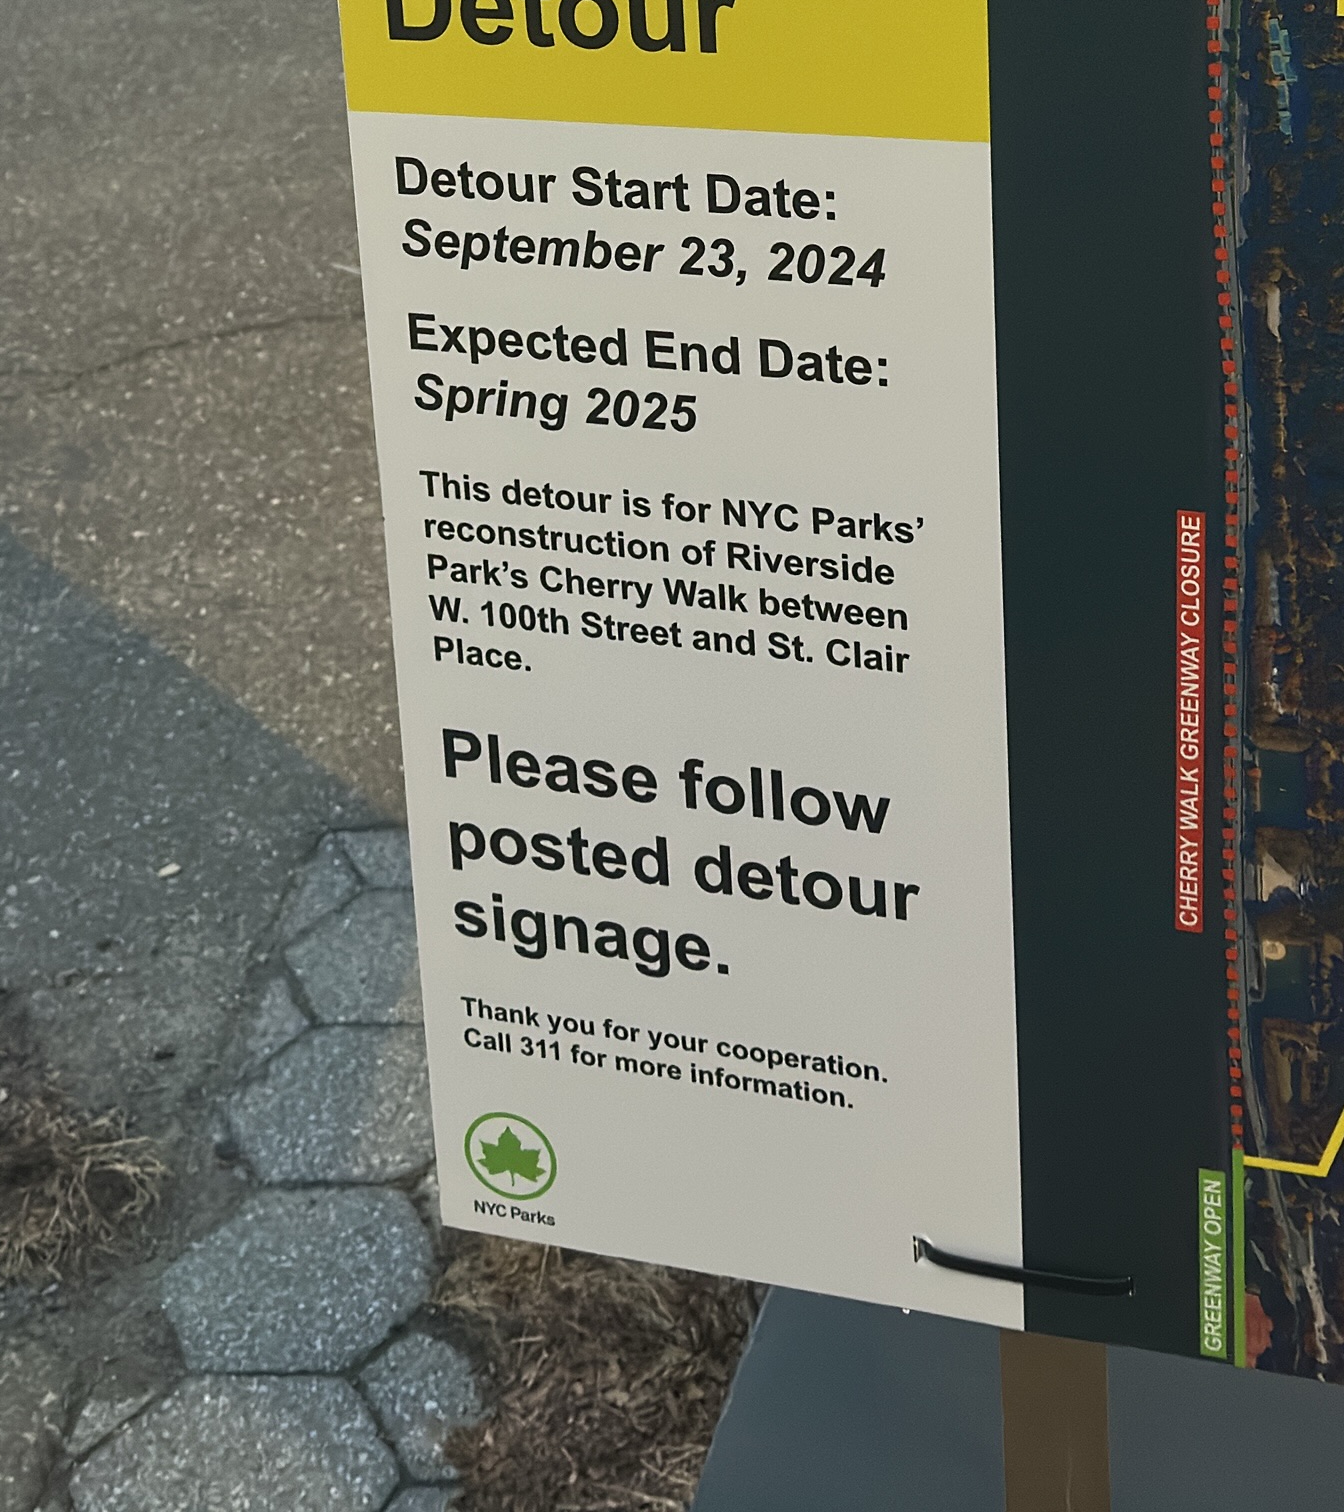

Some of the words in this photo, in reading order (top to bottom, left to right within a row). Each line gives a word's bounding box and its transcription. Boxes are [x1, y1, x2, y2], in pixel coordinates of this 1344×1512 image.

[395, 156, 557, 204] Detour
[571, 166, 691, 212] Start
[706, 173, 836, 221] Date:
[401, 218, 666, 273] September
[679, 236, 747, 287] 23,
[767, 241, 886, 288] 2024
[407, 312, 628, 367] Expected
[645, 329, 741, 376] End
[759, 338, 888, 387] Date:
[414, 372, 569, 432] Spring
[585, 387, 697, 433] 2025
[418, 470, 491, 503] This
[501, 478, 612, 514] detour
[622, 488, 652, 518] is
[661, 492, 712, 524] for
[722, 498, 799, 532] NYC
[424, 518, 670, 563] reconstruction
[681, 539, 717, 567] of
[726, 541, 895, 586] Riverside
[1181, 515, 1201, 628] CLOSURE
[428, 594, 469, 624] W.
[480, 600, 570, 635] 100th
[581, 611, 683, 648] Street
[692, 628, 756, 657] and
[767, 631, 813, 663] St.
[826, 638, 911, 674] Clair
[539, 565, 653, 609] Cherry
[662, 577, 749, 613] Walk
[759, 587, 908, 631] between
[433, 635, 532, 672] Place.
[1180, 632, 1201, 762] GREENWAY
[442, 728, 658, 804] Please
[678, 758, 891, 834] follow
[1179, 766, 1200, 831] WALK
[449, 821, 670, 887] posted
[694, 844, 921, 921] detour
[1179, 835, 1199, 928] CHERRY
[454, 892, 729, 978] signage.
[460, 996, 540, 1028] Thank
[546, 1013, 595, 1036] you
[602, 1018, 641, 1043] for
[647, 1030, 709, 1054] your
[716, 1041, 888, 1084] cooperation.
[463, 1027, 512, 1053] Call
[520, 1036, 560, 1061] 311
[570, 1043, 608, 1068] for
[615, 1055, 682, 1081] more
[690, 1062, 854, 1109] information.
[473, 1198, 508, 1219] NYC
[509, 1205, 556, 1228] Parks
[1203, 1178, 1222, 1236] OPEN
[1204, 1240, 1222, 1352] GREENWAY
